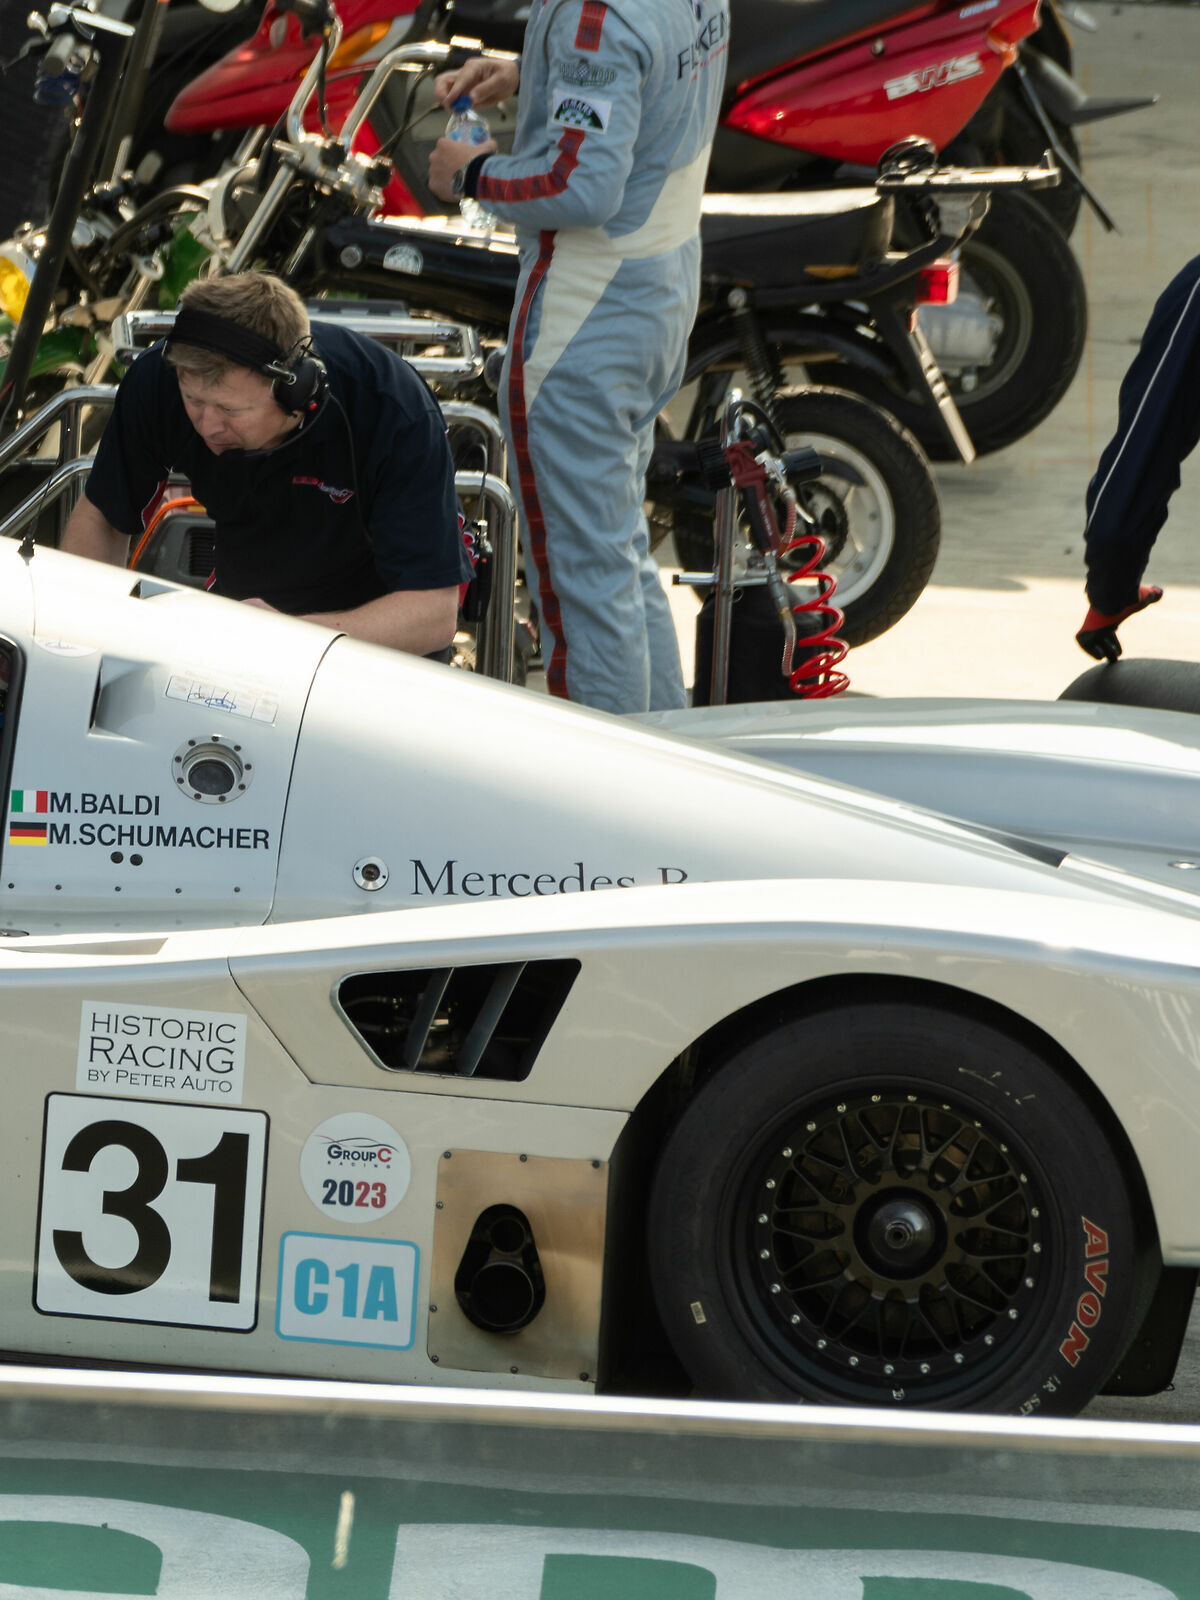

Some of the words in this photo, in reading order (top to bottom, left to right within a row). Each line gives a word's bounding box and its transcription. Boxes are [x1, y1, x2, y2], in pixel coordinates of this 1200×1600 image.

[49, 791, 161, 816] M.BALDI
[48, 822, 270, 850] M.SCHUMACHER
[90, 1011, 237, 1045] HISTORIC
[88, 1036, 235, 1075] RACING
[87, 1068, 112, 1083] BY
[114, 1069, 176, 1089] PETER
[180, 1075, 233, 1094] AUTO
[321, 1178, 387, 1209] 2023
[52, 1119, 250, 1304] 31
[294, 1257, 398, 1322] C1A
[1059, 1215, 1109, 1368] AVON
